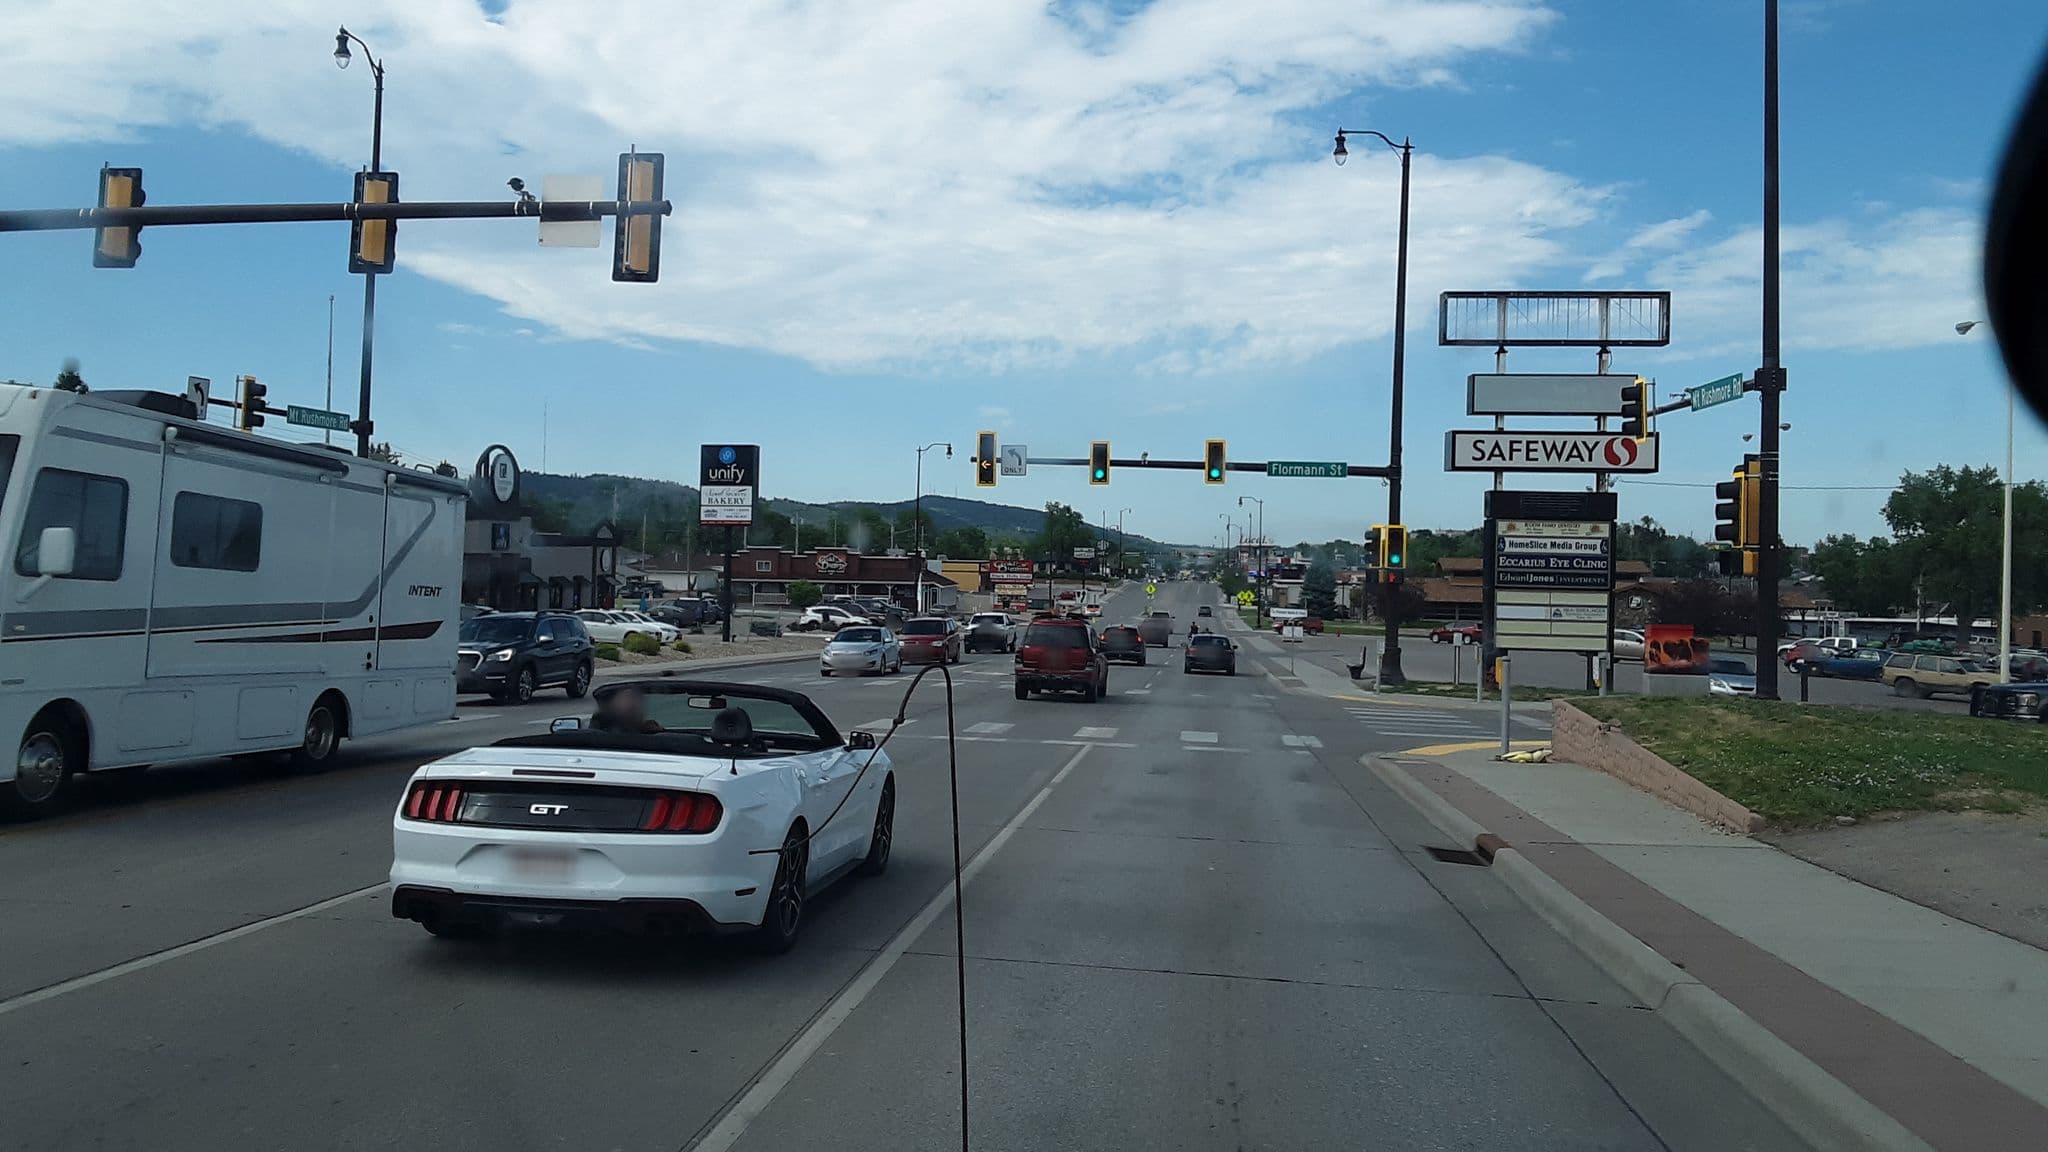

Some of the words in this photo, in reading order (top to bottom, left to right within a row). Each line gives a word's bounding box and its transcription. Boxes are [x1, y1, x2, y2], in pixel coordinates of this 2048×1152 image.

[1692, 390, 1700, 408] Mt
[1701, 384, 1731, 407] Rushmore
[1732, 377, 1741, 397] Rd
[301, 410, 337, 427] Rushmore
[339, 415, 348, 430] Rd
[1471, 439, 1601, 462] SAFEWAY
[709, 463, 745, 483] unify
[1272, 463, 1325, 475] Flormann
[1330, 464, 1342, 476] St
[708, 497, 745, 505] BAKERY
[1508, 540, 1547, 549] HomeSlice
[1550, 541, 1572, 550] Media
[1575, 542, 1598, 551] Group
[1499, 556, 1546, 567] ECCARIUS
[1549, 557, 1570, 568] EYE
[1573, 558, 1607, 568] CLINIC
[408, 584, 442, 597] INTENT
[530, 804, 568, 815] GT
